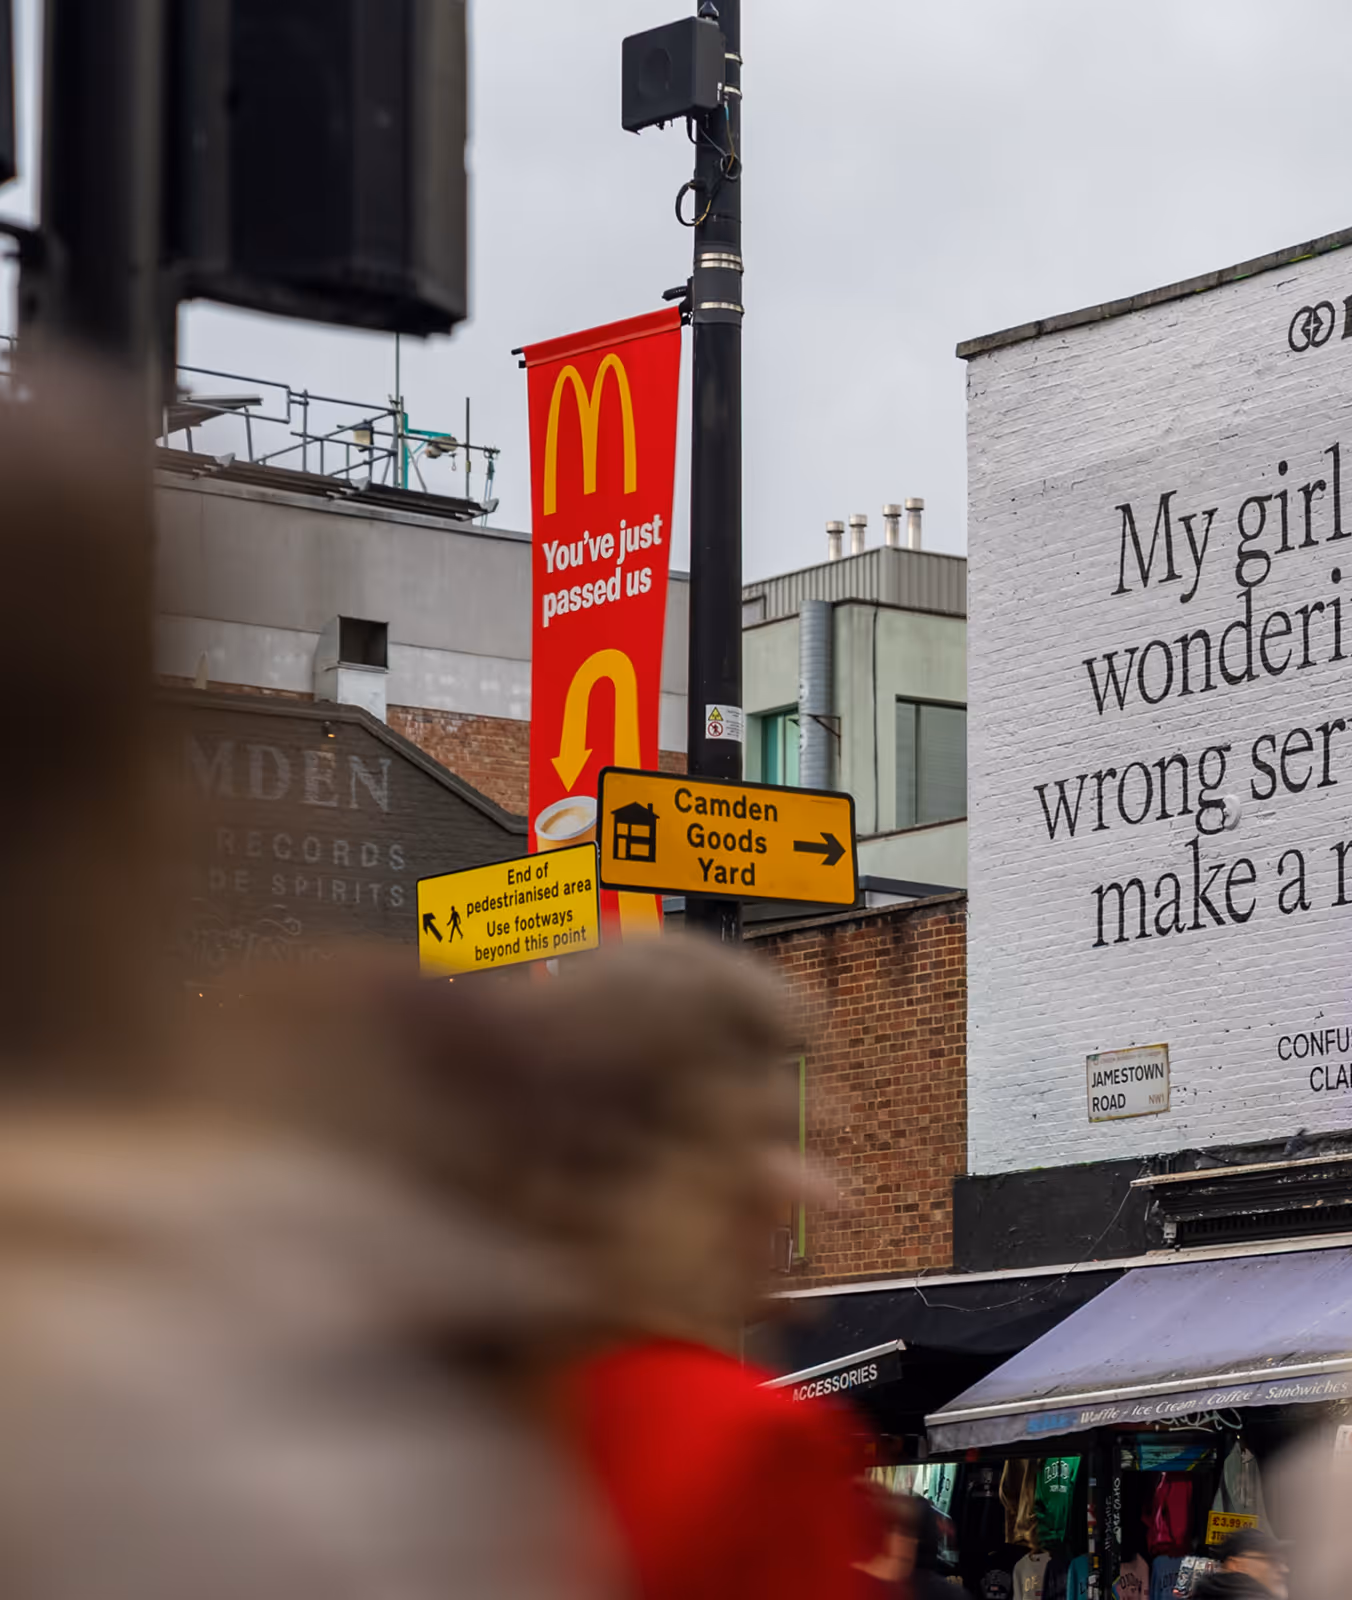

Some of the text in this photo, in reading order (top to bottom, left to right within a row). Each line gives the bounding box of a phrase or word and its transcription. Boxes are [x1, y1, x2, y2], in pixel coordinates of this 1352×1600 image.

[1111, 490, 1218, 603] My
[1235, 442, 1352, 588] girl
[542, 514, 663, 574] You've just
[542, 566, 652, 628] passed us
[188, 737, 392, 813] MDEN
[1033, 743, 1231, 840] wrong
[674, 787, 778, 822] Camden
[216, 827, 406, 871] RECORDS
[687, 823, 767, 854] Goods
[271, 873, 405, 908] SPIRITS
[507, 861, 549, 885] End of
[698, 857, 755, 886] Yard
[466, 879, 592, 919] pedestrianised area
[1091, 837, 1257, 947] make
[1277, 848, 1311, 915] a
[487, 910, 573, 938] Use footways
[475, 925, 587, 962] beyond this point
[1091, 1063, 1164, 1088] JAMESTOWN
[1092, 1093, 1164, 1112] ROAD NW1
[792, 1363, 878, 1402] ACCESSORIES
[1080, 1409, 1118, 1425] Waffle
[1131, 1404, 1152, 1417] Ice
[1155, 1398, 1196, 1415] Cream
[1206, 1389, 1253, 1406] Coffee
[1265, 1379, 1349, 1400] Sandwiches
[1212, 1516, 1241, 1528] £3.99
